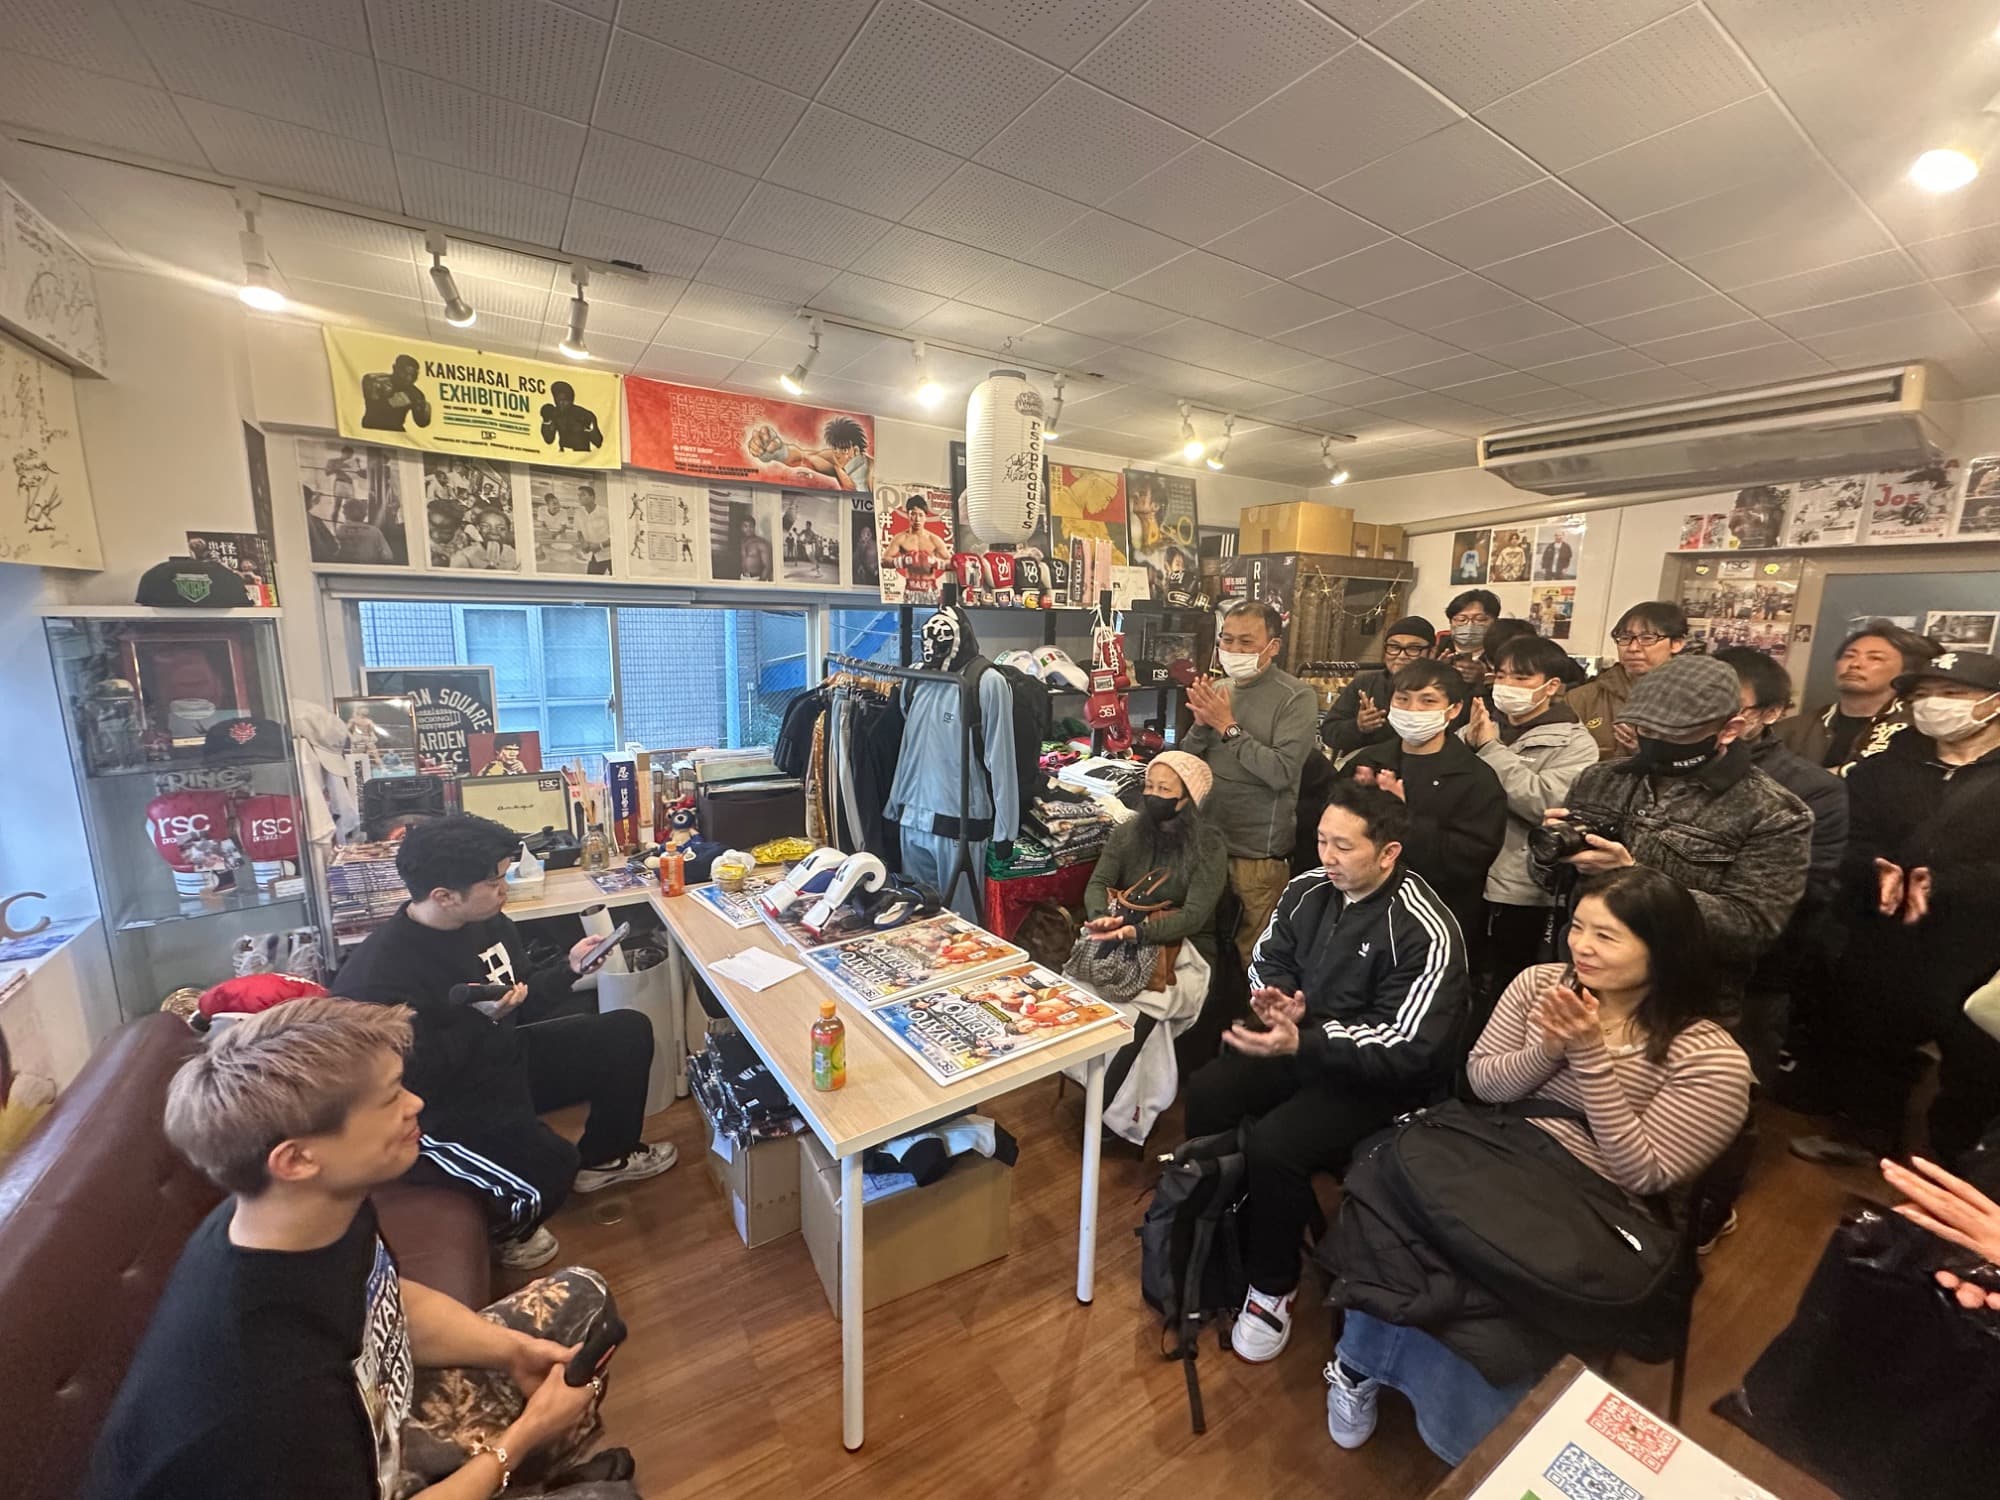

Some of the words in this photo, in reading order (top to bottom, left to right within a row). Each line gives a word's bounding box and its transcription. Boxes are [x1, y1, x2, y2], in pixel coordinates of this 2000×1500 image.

[425, 361, 546, 394] KANSHASAI_RSC
[439, 383, 530, 413] EXHIBITION
[1152, 669, 1169, 679] rsc
[158, 814, 210, 837] rsc
[252, 818, 292, 837] rsc
[834, 950, 892, 985] HAYATO
[904, 1008, 972, 1055] HAYATO
[940, 1002, 998, 1040] REITO
